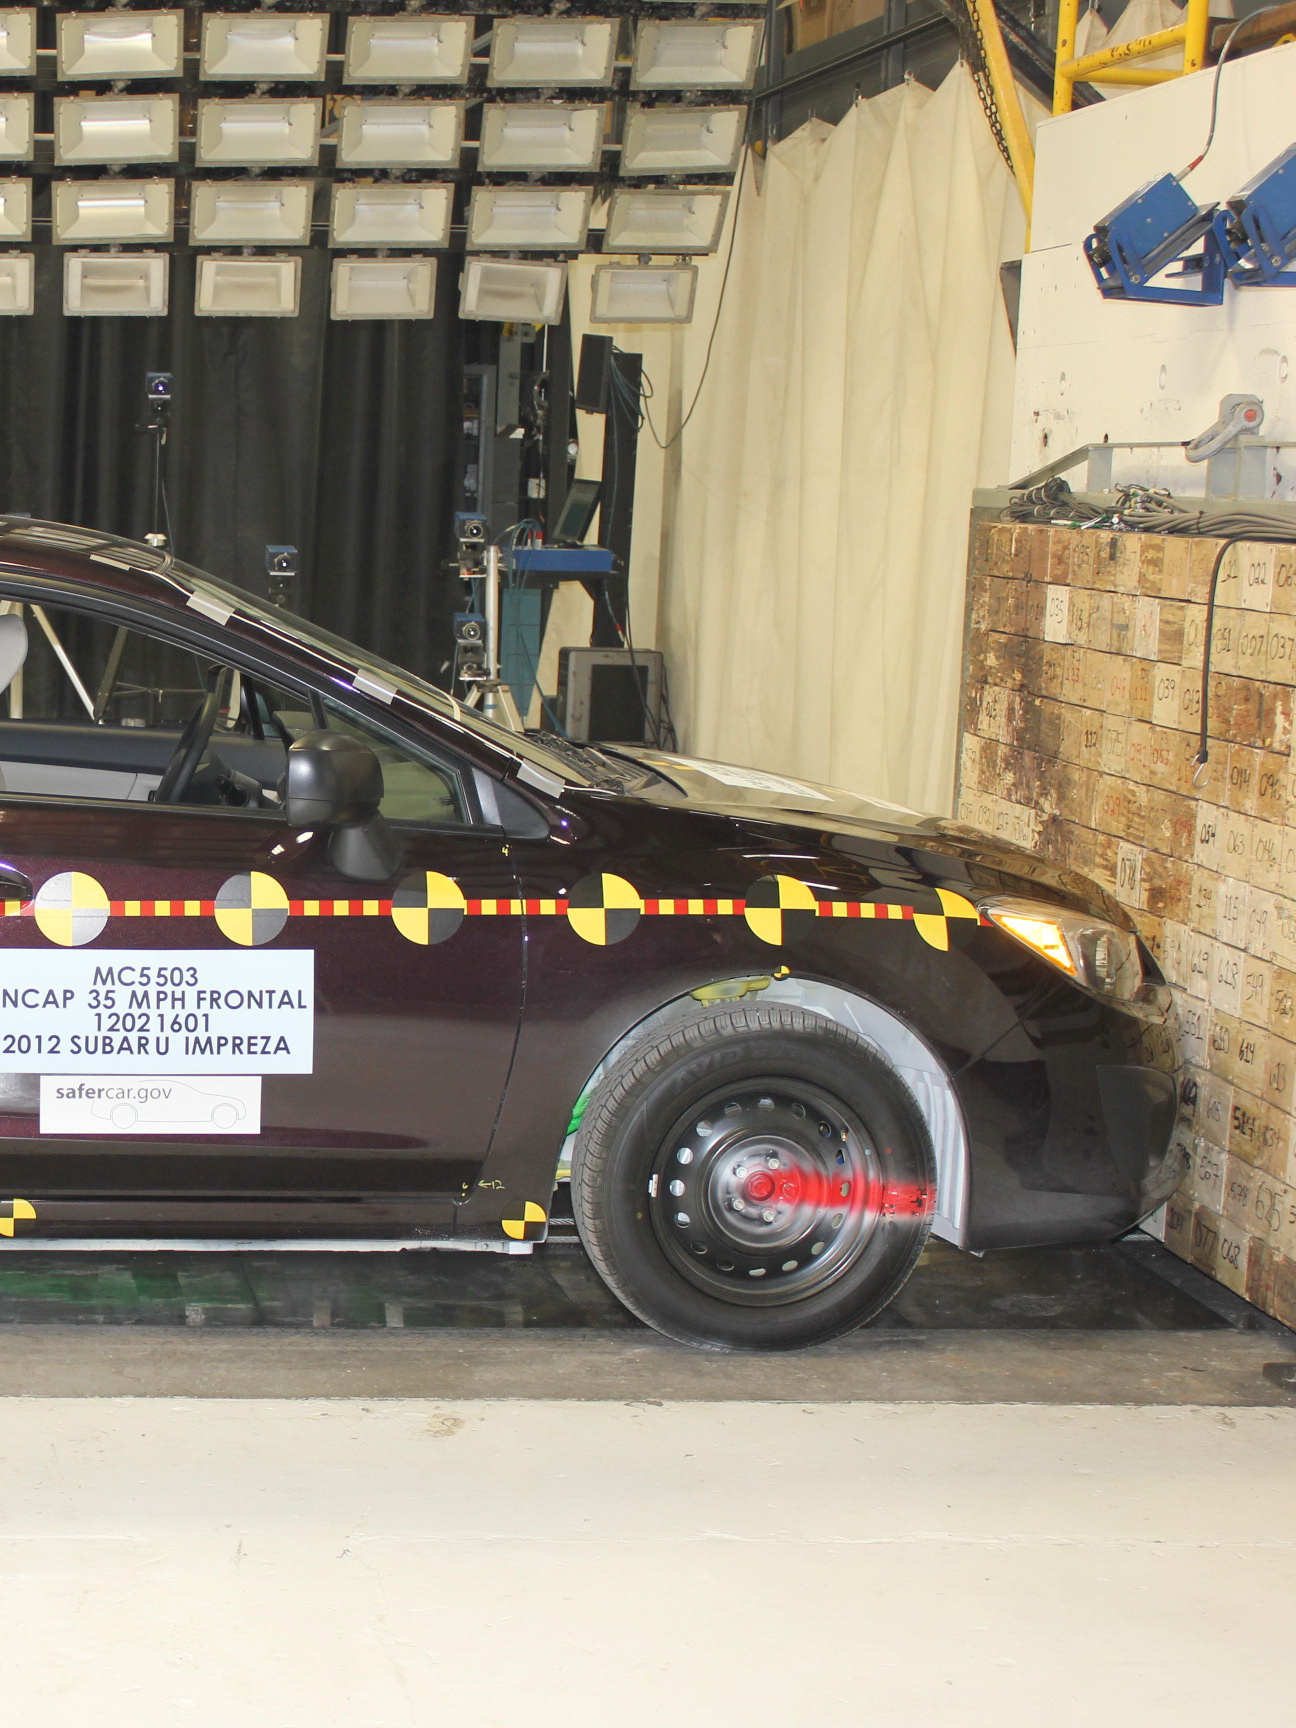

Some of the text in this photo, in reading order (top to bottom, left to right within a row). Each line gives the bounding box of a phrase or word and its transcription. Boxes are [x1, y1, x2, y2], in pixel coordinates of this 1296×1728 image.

[1247, 562, 1267, 587] 022
[1049, 597, 1064, 624] 035
[1269, 632, 1295, 661] 037
[1157, 678, 1176, 702] 039
[1085, 729, 1098, 749] 112
[1152, 748, 1170, 765] 053
[1230, 766, 1251, 793] 014
[1200, 823, 1217, 848] 054
[1226, 830, 1245, 856] 063
[1222, 893, 1239, 921] 115
[92, 966, 199, 987] MC5503
[1217, 957, 1238, 989] 618
[2, 988, 307, 1010] NCAP 35 MPH FRONTAL
[94, 1012, 210, 1033] 12021601
[2, 1034, 291, 1056] 2012 SUBARU IMPREZA
[1238, 1038, 1256, 1066] 614
[55, 1083, 173, 1104] safercar.gov
[1198, 1154, 1219, 1189] 507
[1255, 1180, 1283, 1231] 625
